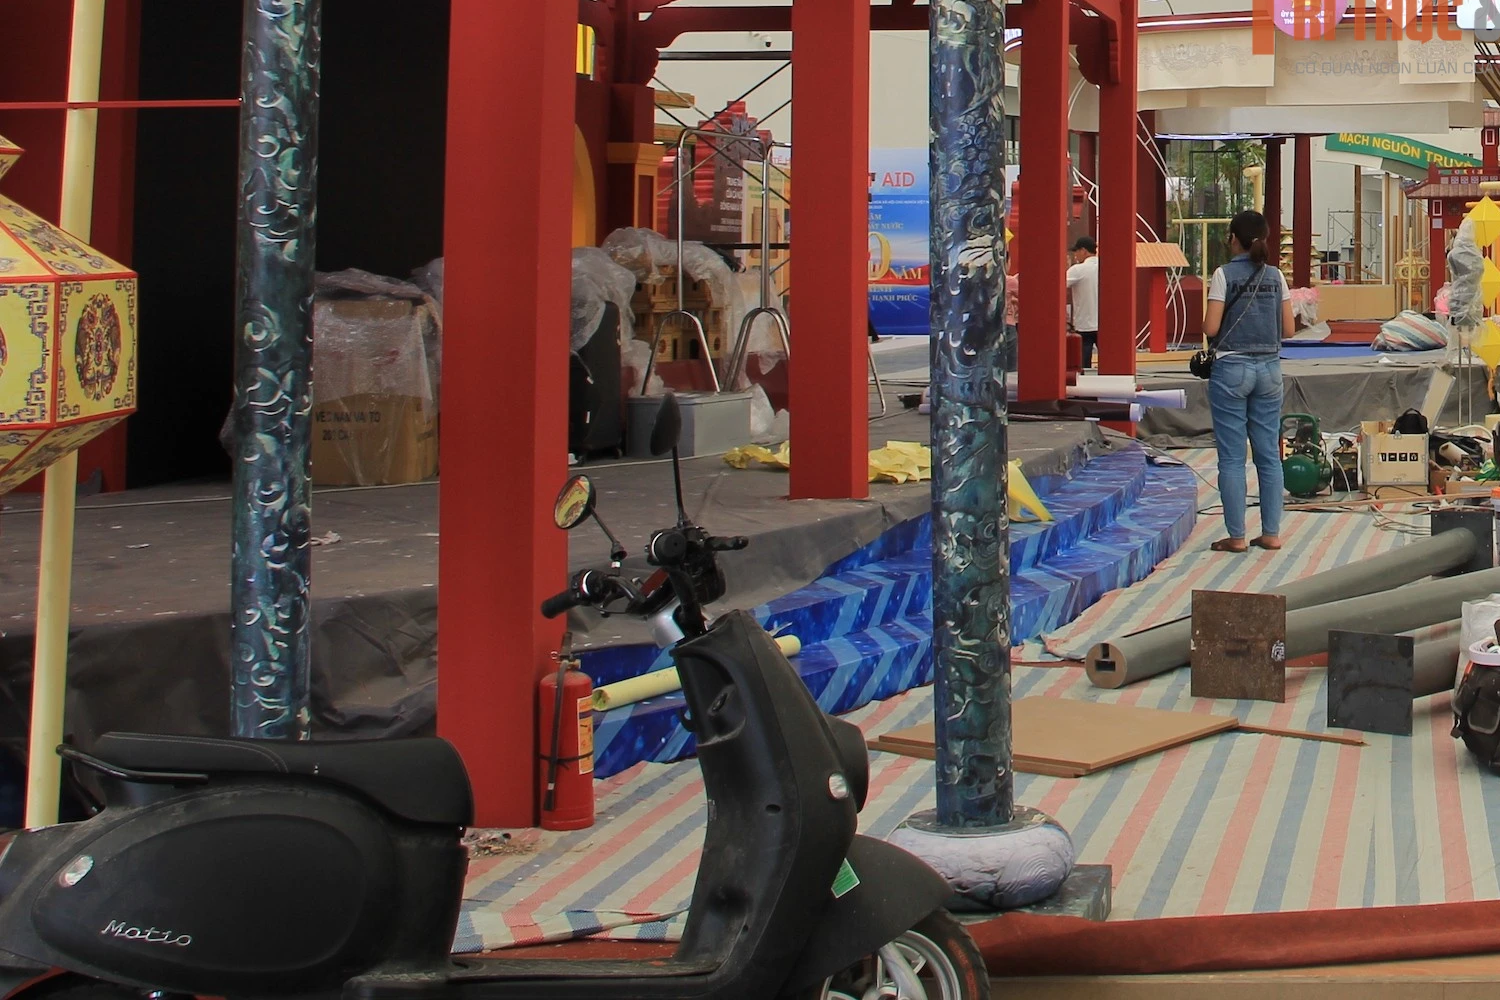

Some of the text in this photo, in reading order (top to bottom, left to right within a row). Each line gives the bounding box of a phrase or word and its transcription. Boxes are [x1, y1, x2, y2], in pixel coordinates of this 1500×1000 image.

[1339, 133, 1369, 146] MẠCH
[1372, 137, 1420, 159] NGUỒN
[882, 172, 915, 187] AID
[890, 265, 922, 280] NĂM
[896, 293, 918, 301] PHÚC
